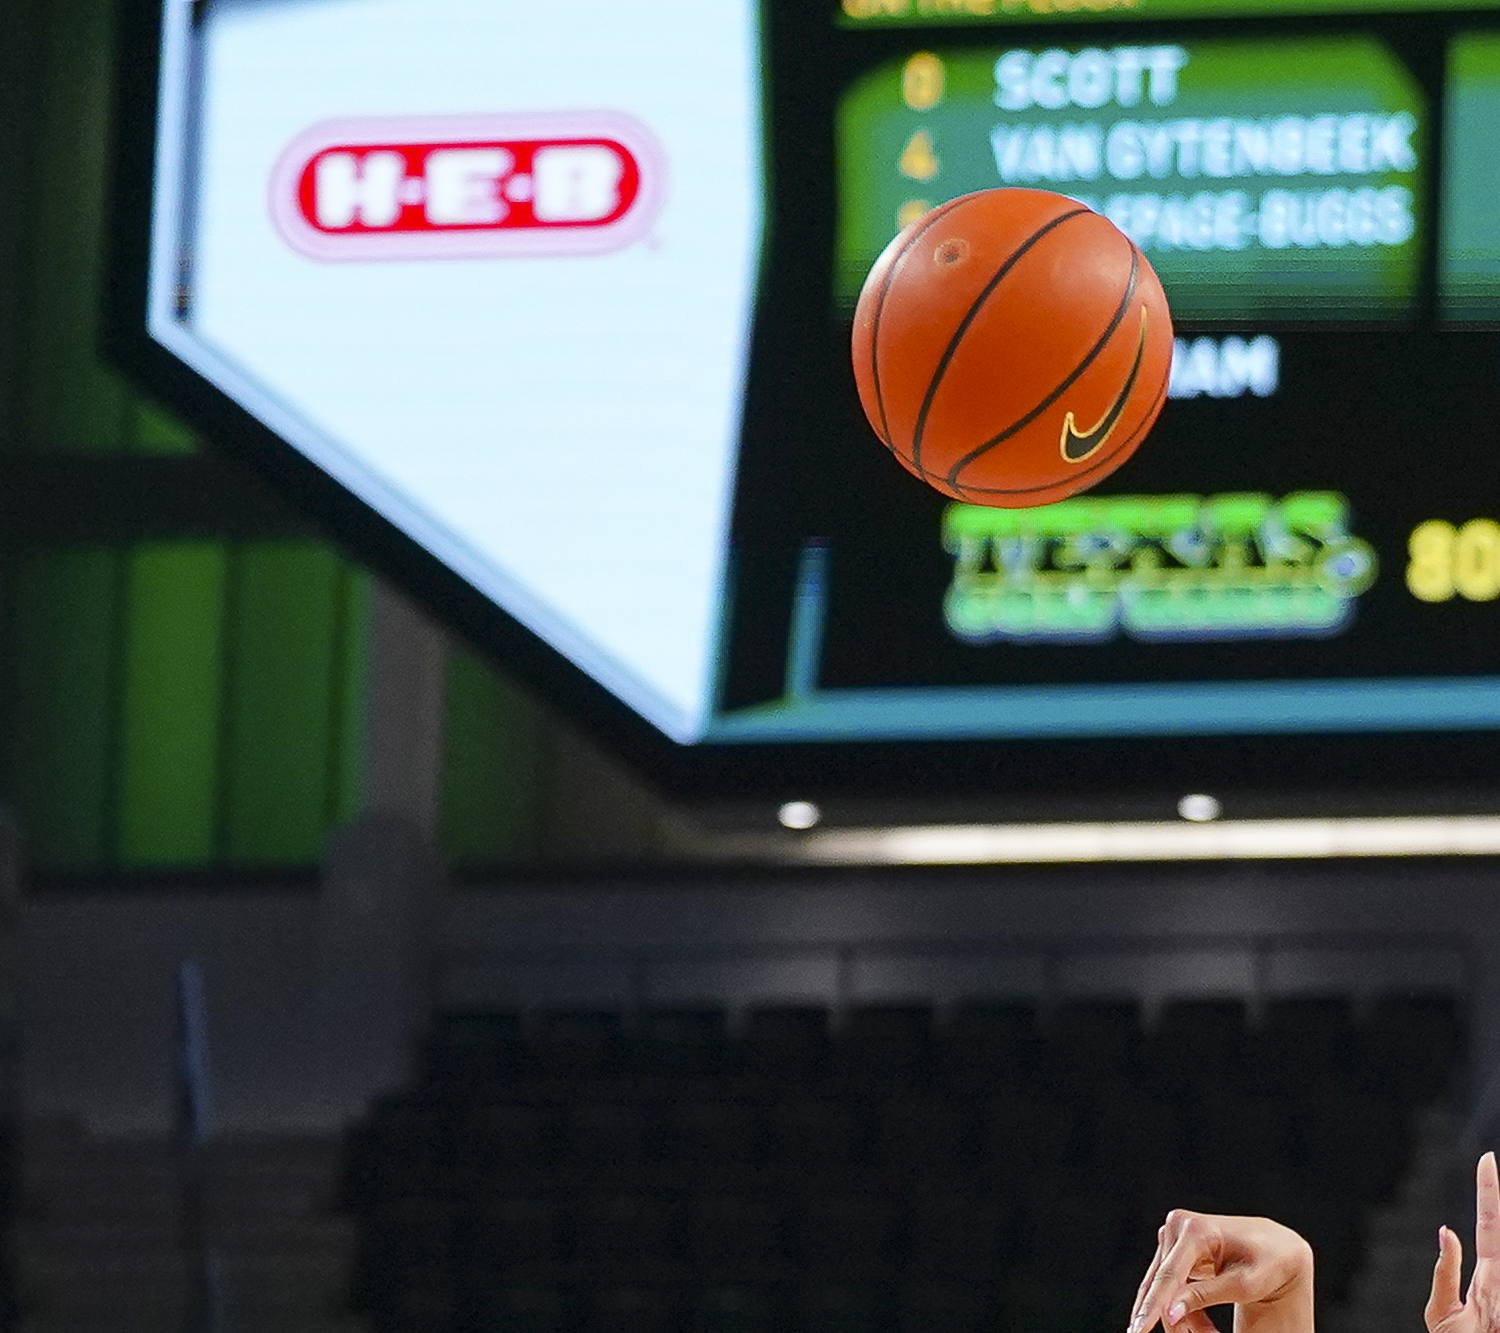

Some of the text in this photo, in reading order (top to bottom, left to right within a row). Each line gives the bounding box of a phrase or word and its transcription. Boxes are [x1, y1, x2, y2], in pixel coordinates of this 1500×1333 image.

[902, 51, 946, 112] 0
[993, 46, 1187, 111] SCOTT
[900, 130, 938, 182] 4
[990, 122, 1101, 182] VAN
